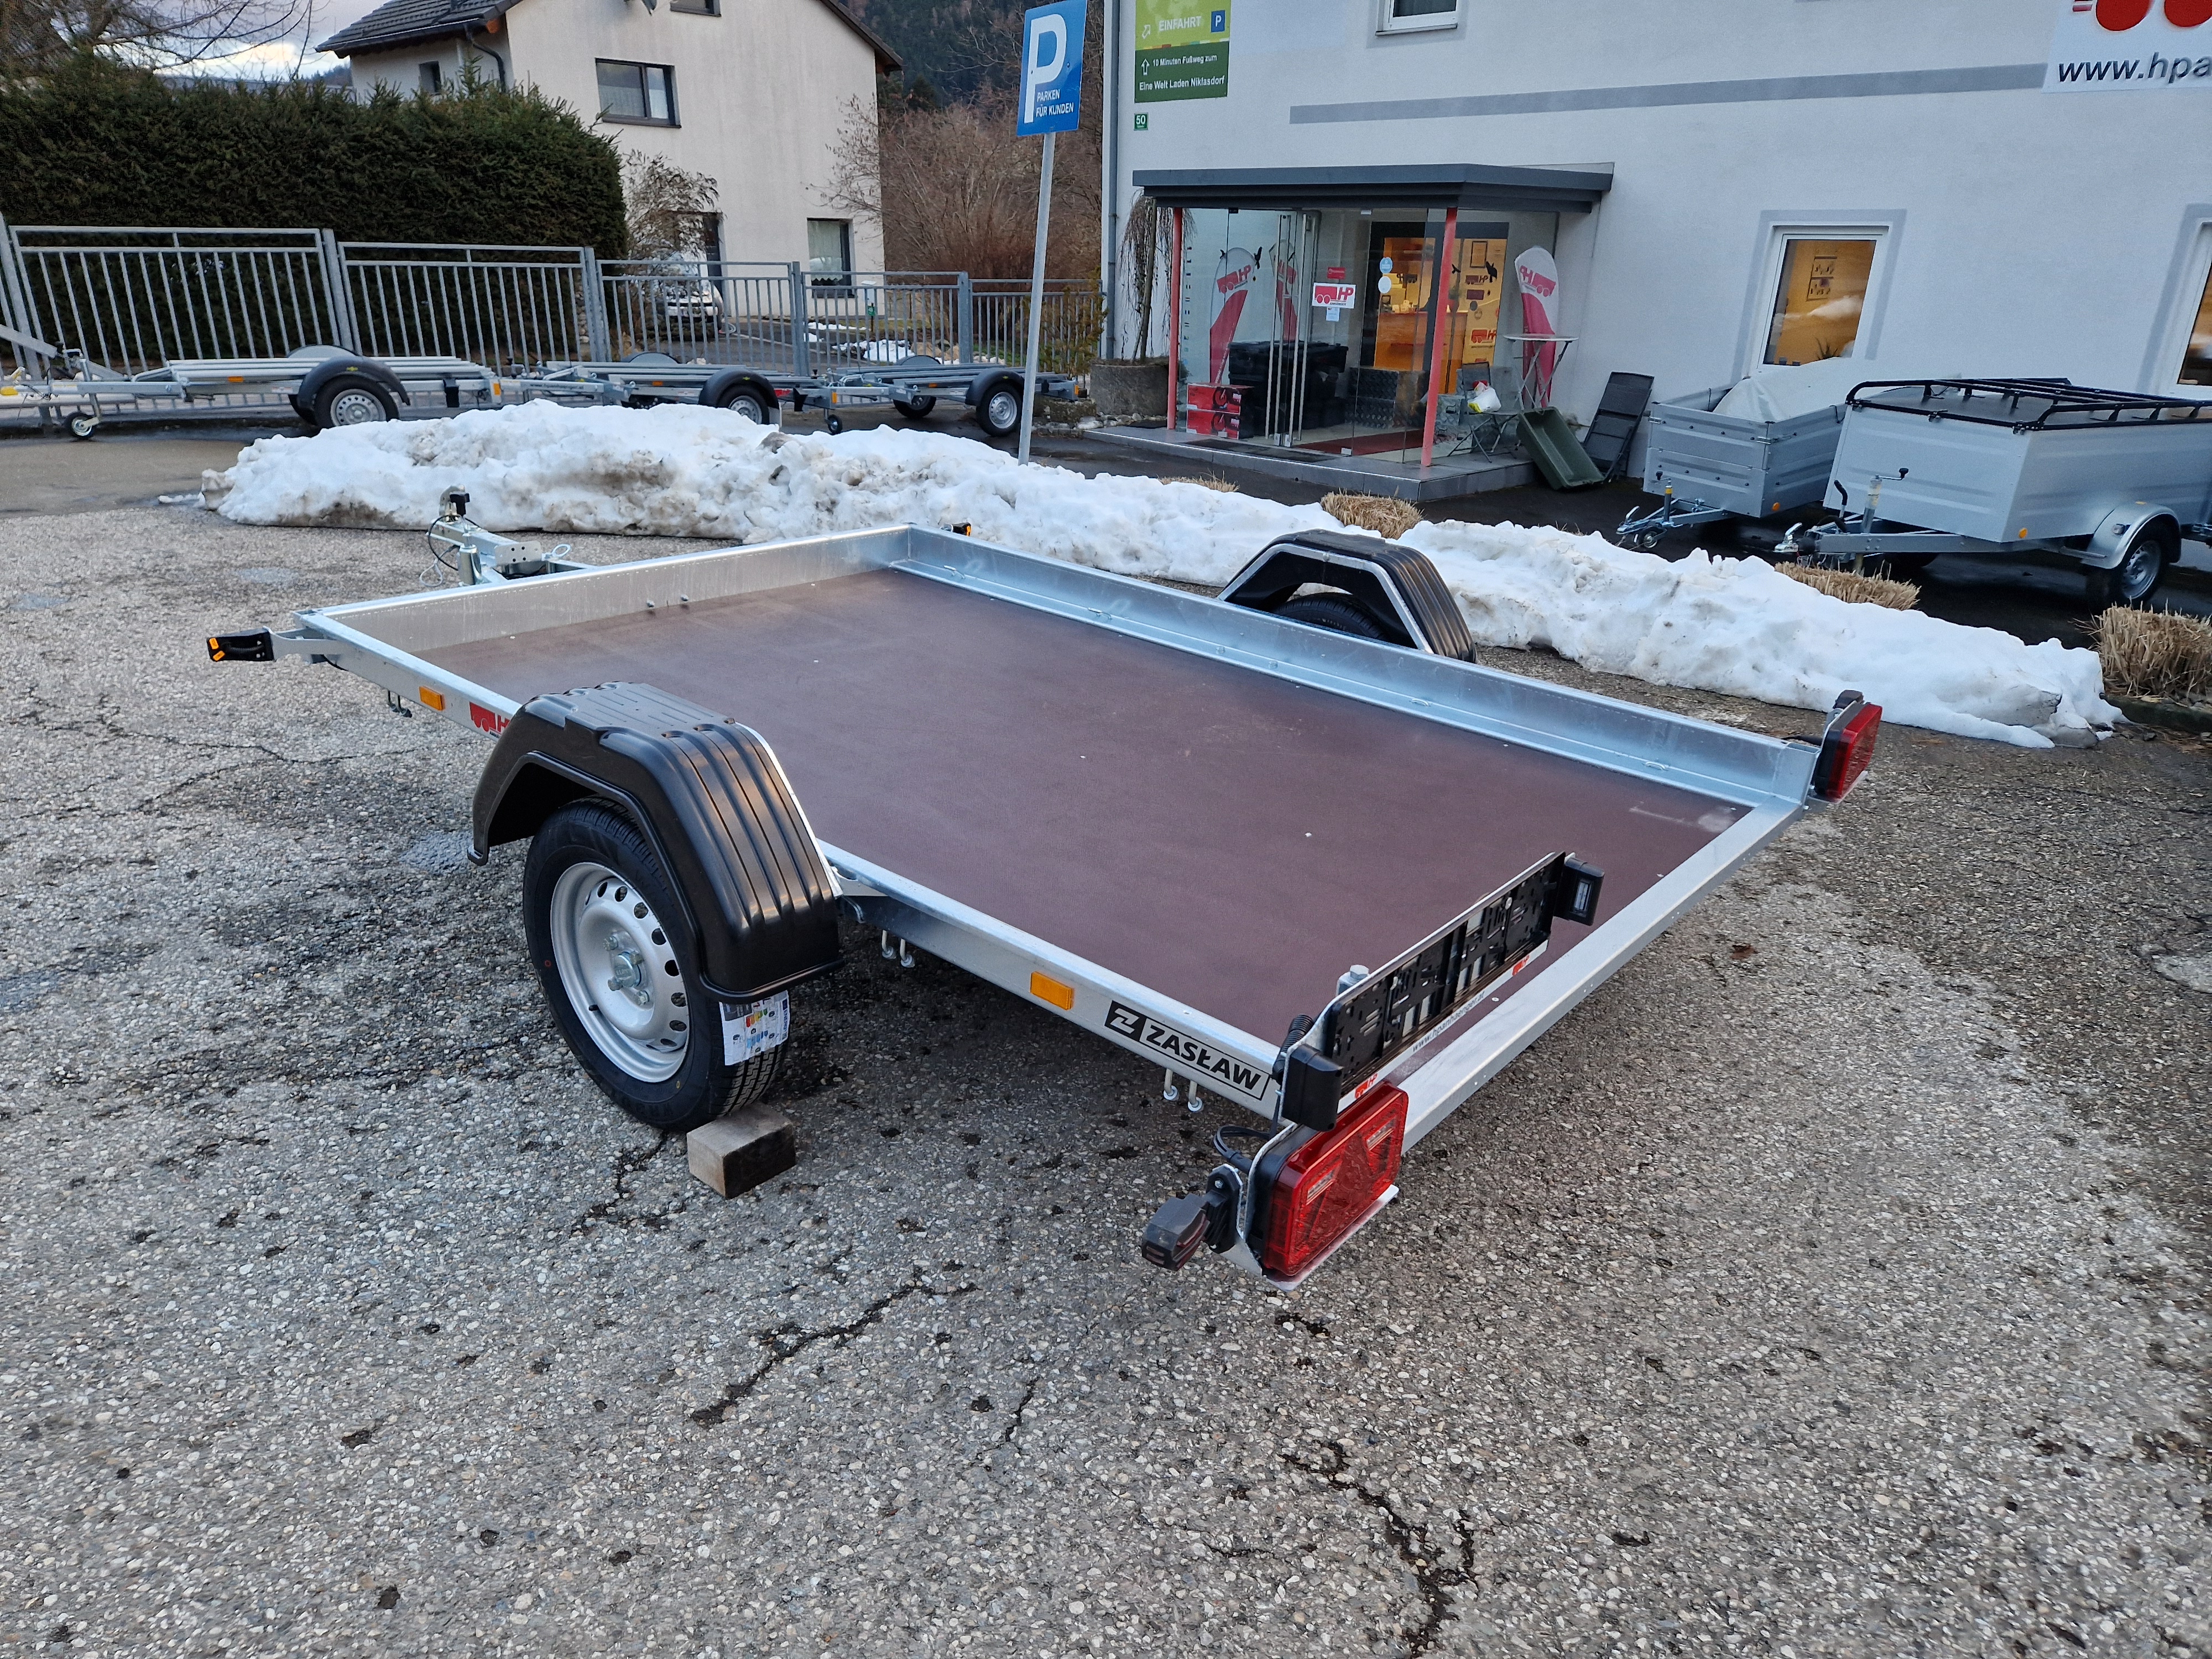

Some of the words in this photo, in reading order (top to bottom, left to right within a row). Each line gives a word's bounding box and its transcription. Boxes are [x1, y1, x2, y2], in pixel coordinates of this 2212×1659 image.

[1159, 15, 1202, 32] EINFAHRT
[1215, 15, 1222, 27] P
[1160, 58, 1181, 66] Minuten
[1182, 55, 1204, 64] Fußweg
[1024, 14, 1067, 123] P
[1139, 81, 1153, 91] Eine
[1154, 80, 1168, 90] Welt
[1170, 79, 1190, 88] Laden
[1191, 75, 1225, 86] Niklasdorf
[1037, 89, 1060, 102] PARKEN
[1036, 104, 1047, 117] FÜR
[1048, 102, 1074, 116] KUNDEN
[1136, 114, 1146, 124] 50
[1338, 287, 1354, 300] HP
[1146, 1024, 1261, 1091] ZASŁAW
